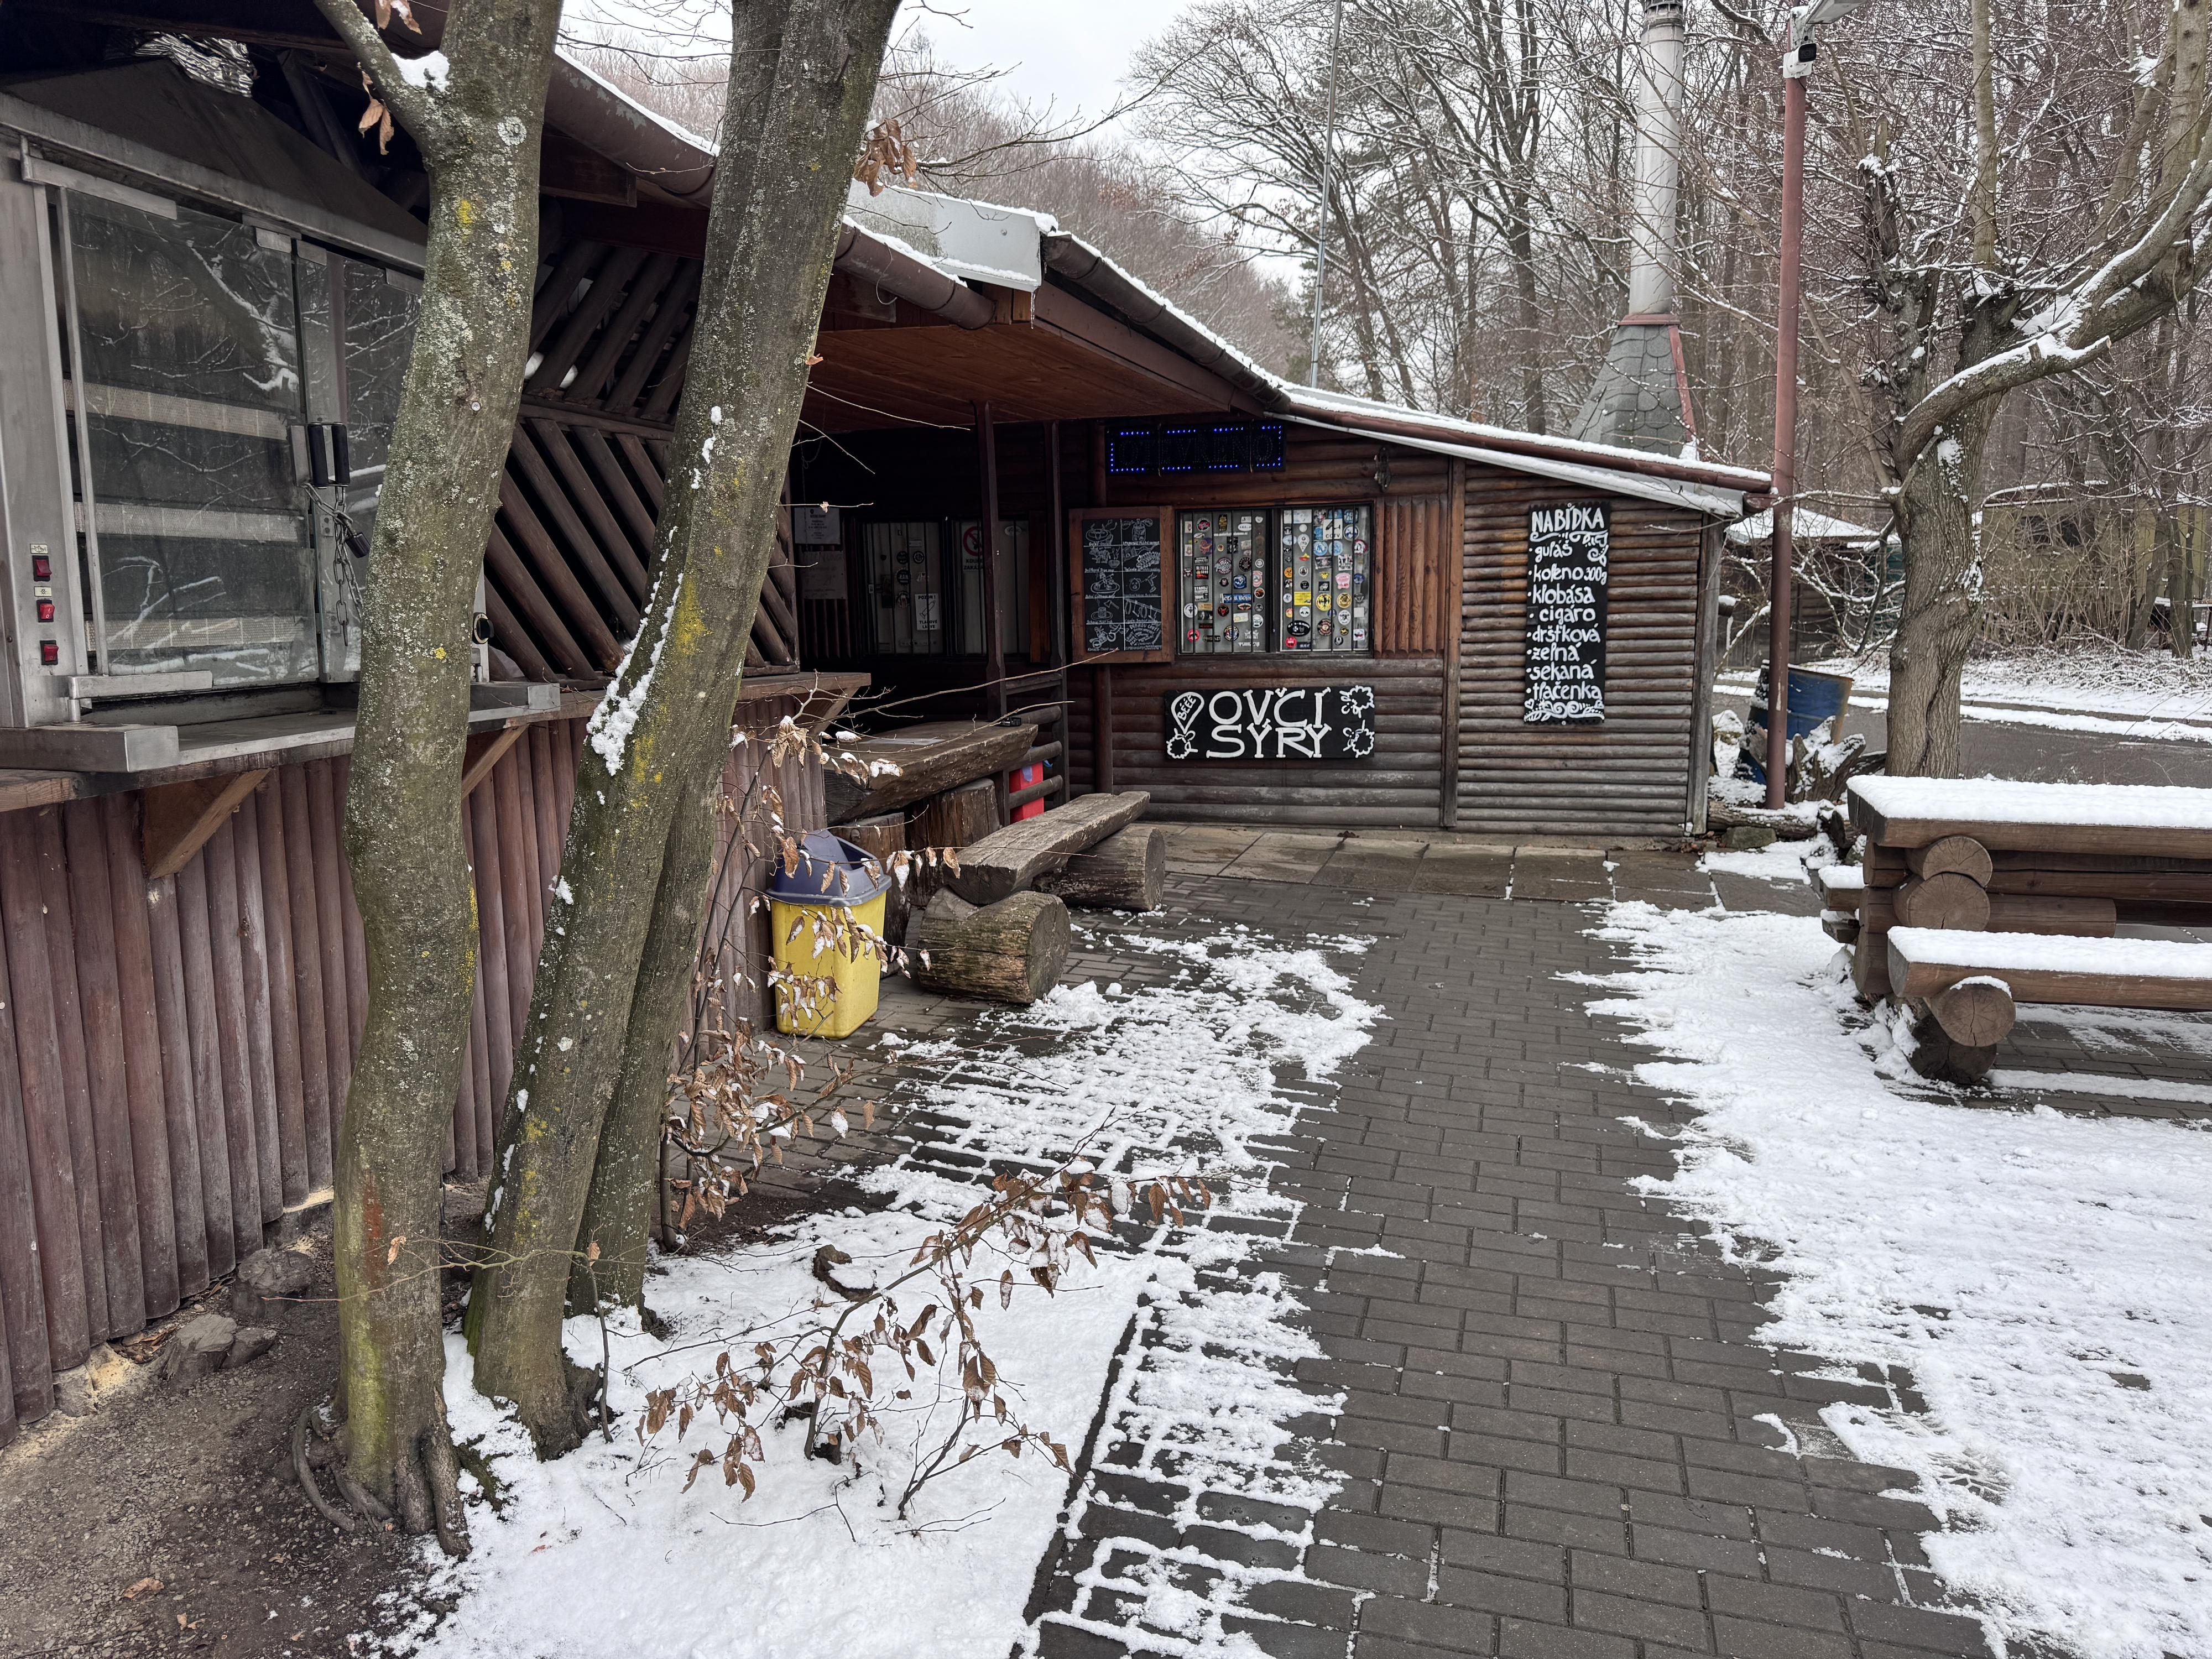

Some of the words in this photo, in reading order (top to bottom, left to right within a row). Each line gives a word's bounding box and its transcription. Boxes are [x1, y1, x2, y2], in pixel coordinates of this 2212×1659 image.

[1532, 505, 1604, 533] NABÍDKA
[1535, 539, 1573, 562] guláš
[1533, 564, 1583, 582] koleno
[1584, 566, 1608, 585] 300g
[1532, 583, 1595, 604] klobása
[1539, 604, 1596, 625] cigáro
[1532, 623, 1601, 643] dršťková
[1531, 642, 1582, 661] zelná
[1530, 660, 1597, 680] sekaná
[1533, 681, 1602, 701] tlačenka
[1209, 687, 1332, 728] OVČÍ
[1206, 718, 1332, 758] SÝRY
